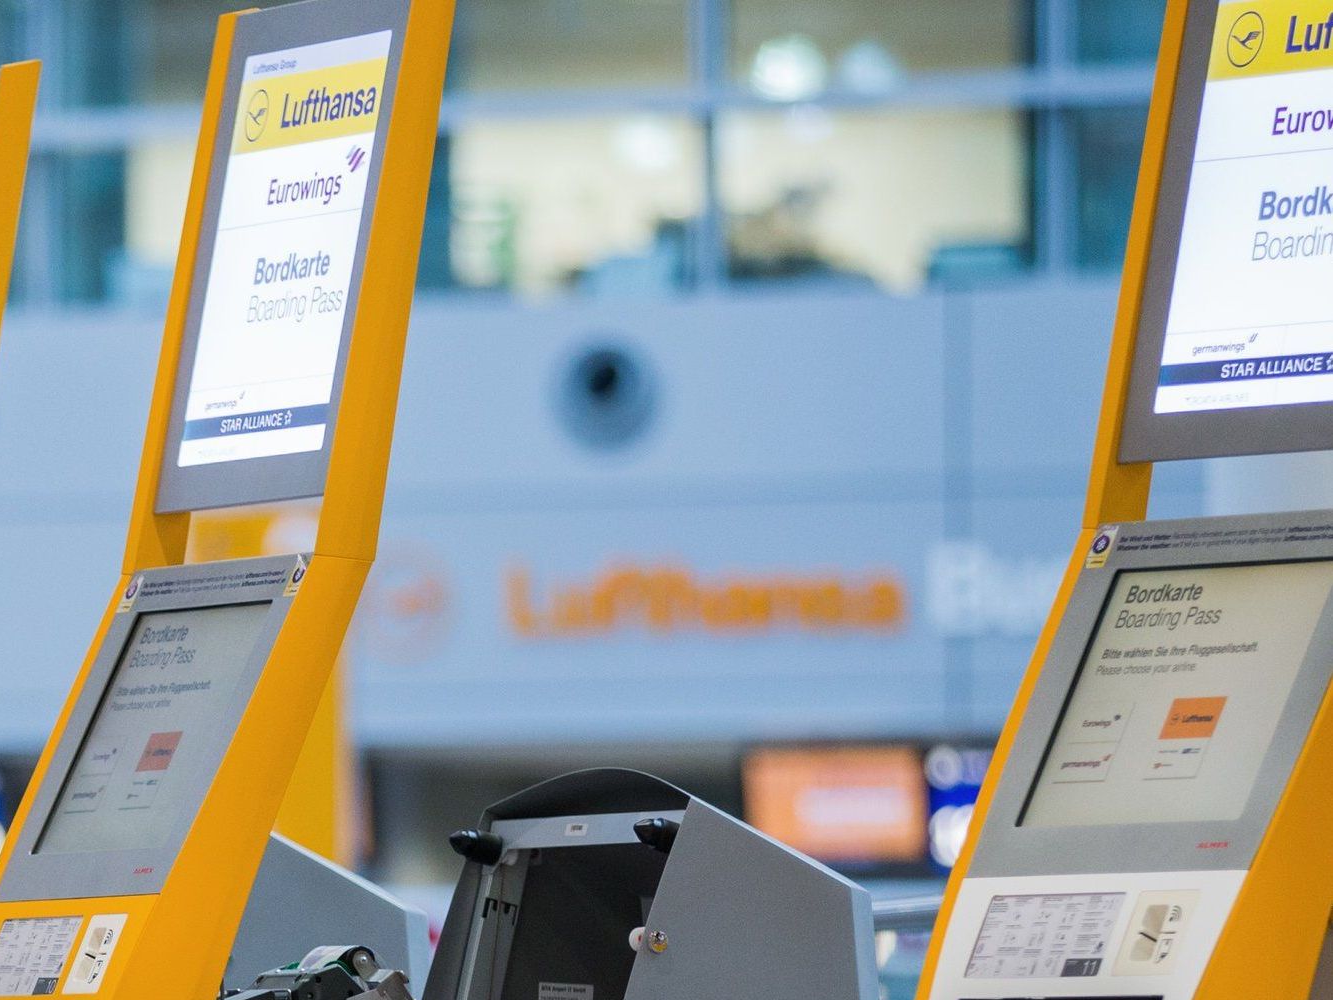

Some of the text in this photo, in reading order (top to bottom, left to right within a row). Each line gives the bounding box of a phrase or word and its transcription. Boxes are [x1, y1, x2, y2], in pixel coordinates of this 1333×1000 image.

[280, 87, 377, 128] Lufthansa
[267, 172, 342, 206] Eurowings
[253, 250, 330, 285] Bordkarte
[247, 286, 343, 323] Boarding Pass
[1192, 341, 1245, 356] germanwings
[1221, 357, 1323, 379] STAR ALLIANCE
[220, 413, 283, 433] STAR ALLIANCE
[507, 556, 905, 640] Lufthansa
[1124, 584, 1204, 604] Bordkarte
[1115, 606, 1223, 631] Boarding Pass
[140, 625, 189, 644] Bordkarte
[129, 646, 196, 669] Boarding Pass
[1101, 648, 1122, 659] Bitte
[1123, 647, 1153, 658] wählen
[1154, 646, 1168, 657] Sie
[1169, 646, 1187, 656] Ihre
[1095, 664, 1122, 676] Please
[1123, 664, 1152, 674] choose
[1152, 664, 1171, 675] your
[1082, 714, 1214, 728] Eurowings Lufthansa
[1083, 960, 1097, 975] 11
[46, 979, 57, 994] 10
